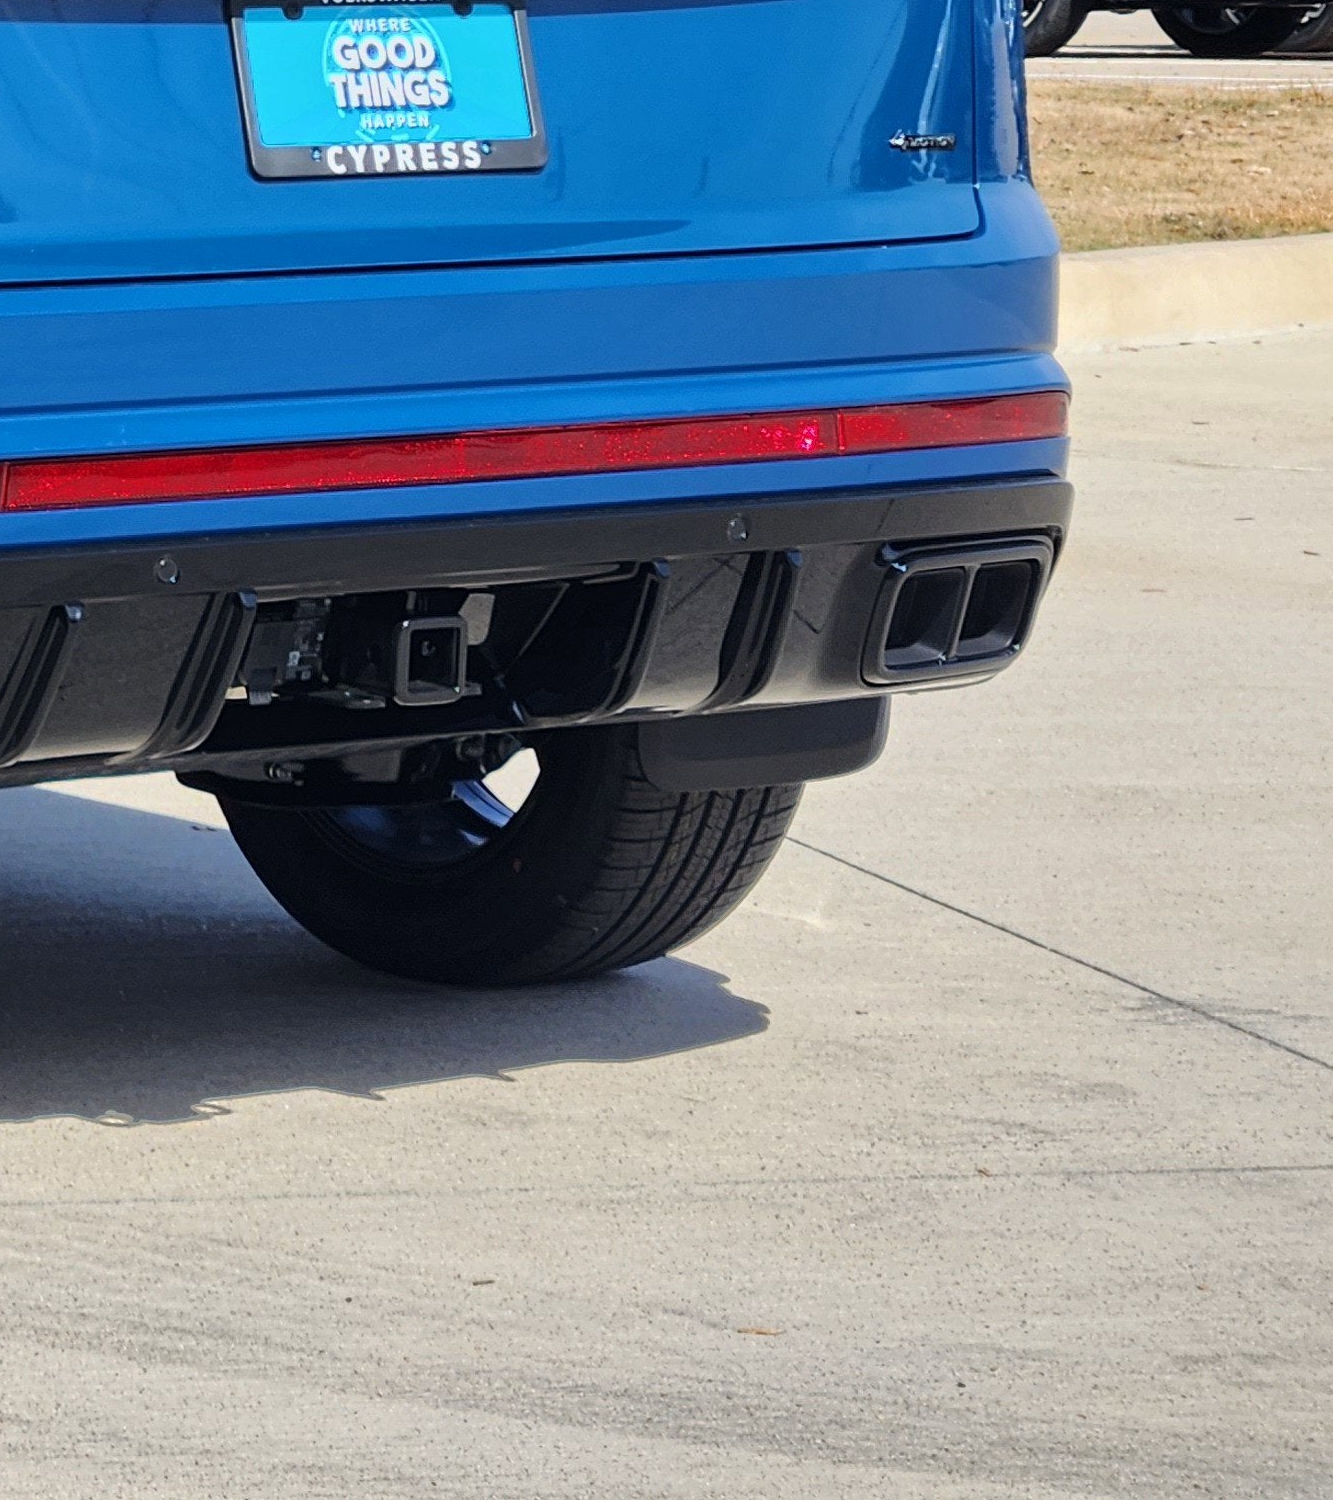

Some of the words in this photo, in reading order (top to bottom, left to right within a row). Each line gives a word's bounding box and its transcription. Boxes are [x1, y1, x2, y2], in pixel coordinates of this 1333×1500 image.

[348, 17, 412, 33] WHERE
[330, 35, 437, 71] GOOD
[328, 69, 453, 109] THINGS
[360, 111, 431, 130] HAPPEN
[326, 140, 482, 175] CYPRESS
